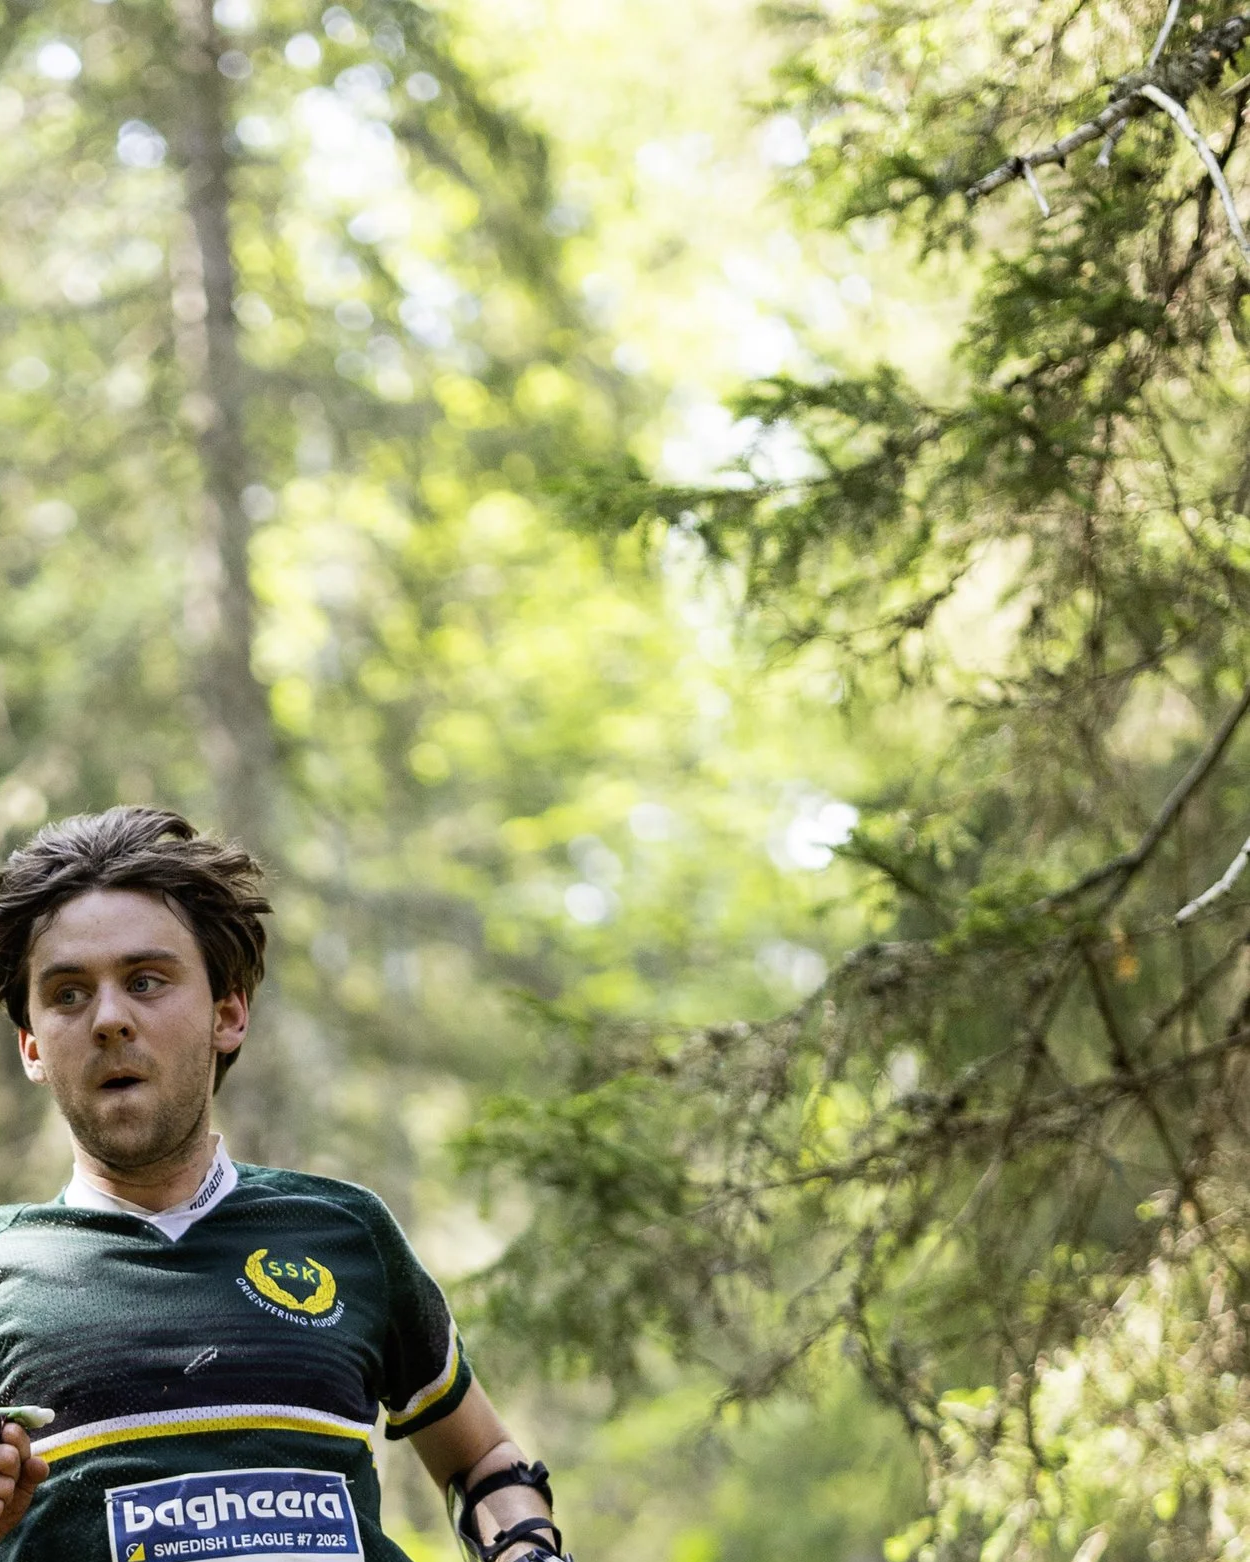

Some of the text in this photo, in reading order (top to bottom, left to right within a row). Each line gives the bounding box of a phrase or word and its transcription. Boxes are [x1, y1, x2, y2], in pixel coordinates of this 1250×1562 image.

[268, 1260, 316, 1284] SSK
[235, 1277, 345, 1328] ORIENTERING HUDDINGE
[123, 1487, 345, 1533] bagheera
[153, 1532, 348, 1557] SWEDISH LEAGUE #7 2025
